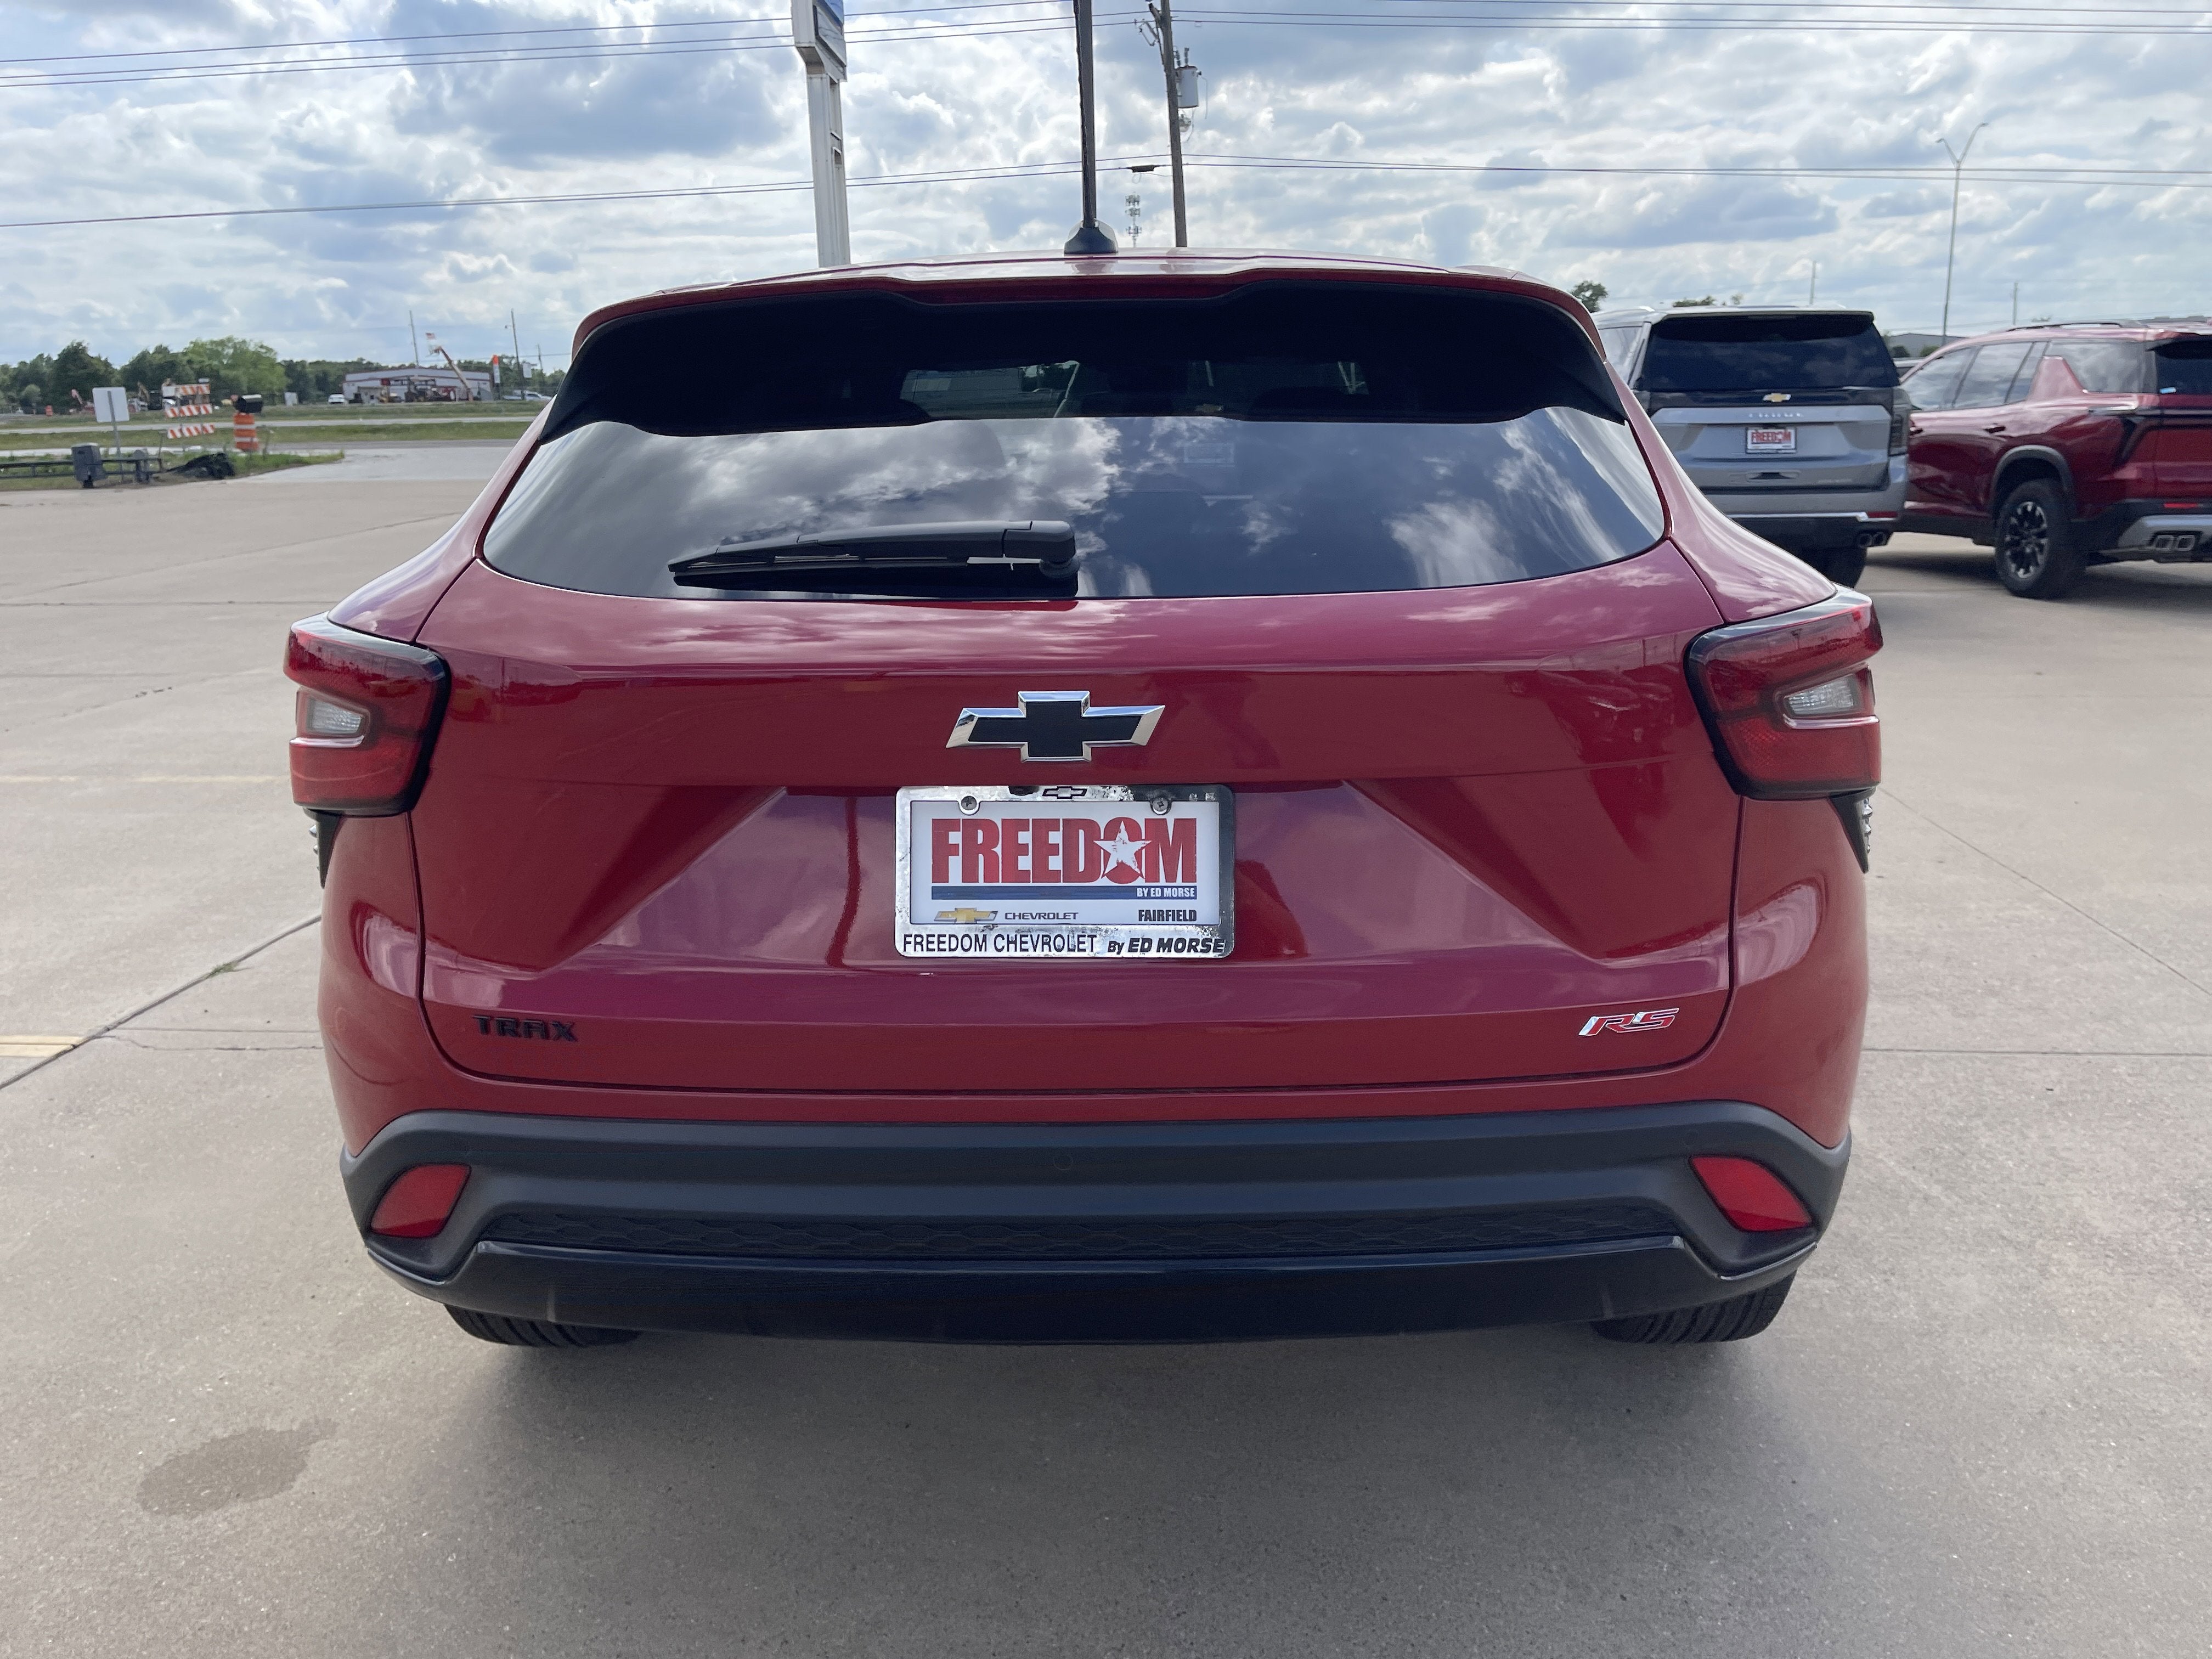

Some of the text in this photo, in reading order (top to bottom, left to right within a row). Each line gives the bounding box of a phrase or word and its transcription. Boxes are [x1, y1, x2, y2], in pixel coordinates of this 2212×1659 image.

[932, 817, 1197, 884] FREEDOM
[1136, 888, 1195, 898] BY ED MORSE
[1005, 912, 1079, 920] CHEVROLET
[1138, 909, 1197, 922] FAIRFIELD
[903, 934, 1226, 955] FREEDOM CHEVROLET By ED MORSE
[472, 1015, 577, 1041] TRAX
[1578, 1008, 1679, 1036] RS
